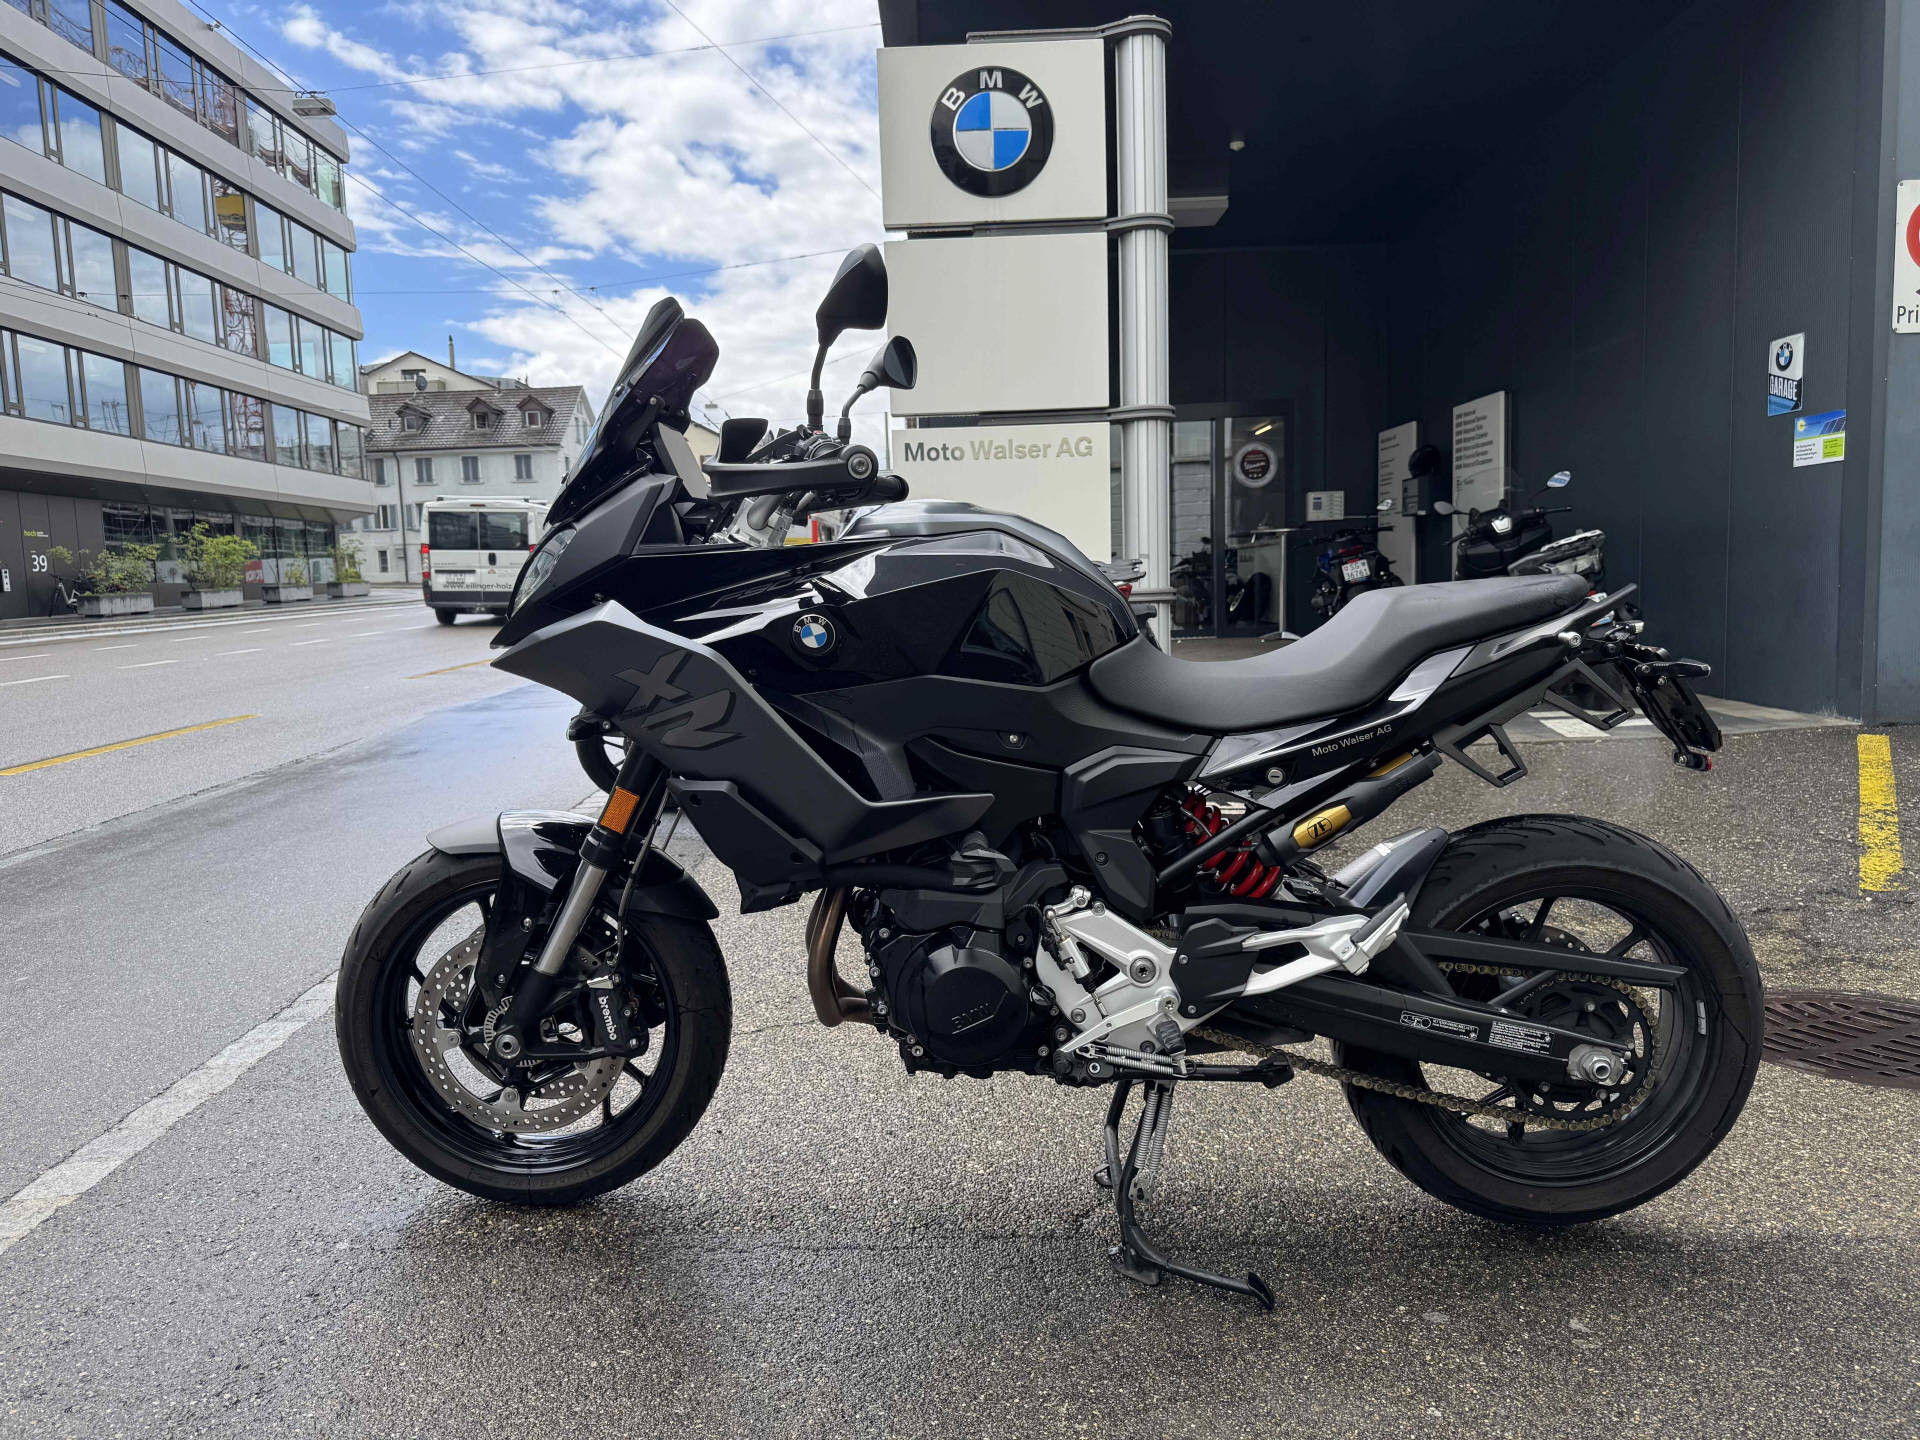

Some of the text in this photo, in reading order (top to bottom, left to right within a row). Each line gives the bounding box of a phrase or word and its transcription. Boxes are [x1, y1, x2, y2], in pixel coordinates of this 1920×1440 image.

[941, 69, 1044, 111] BMW
[1897, 304, 1920, 324] Pri
[1769, 375, 1798, 401] GARAGE
[904, 436, 1093, 462] Moto Walser AG
[31, 554, 48, 572] 39
[1311, 725, 1392, 757] Moto Walser AG
[1307, 820, 1329, 840] ZF
[598, 995, 617, 1041] brembo
